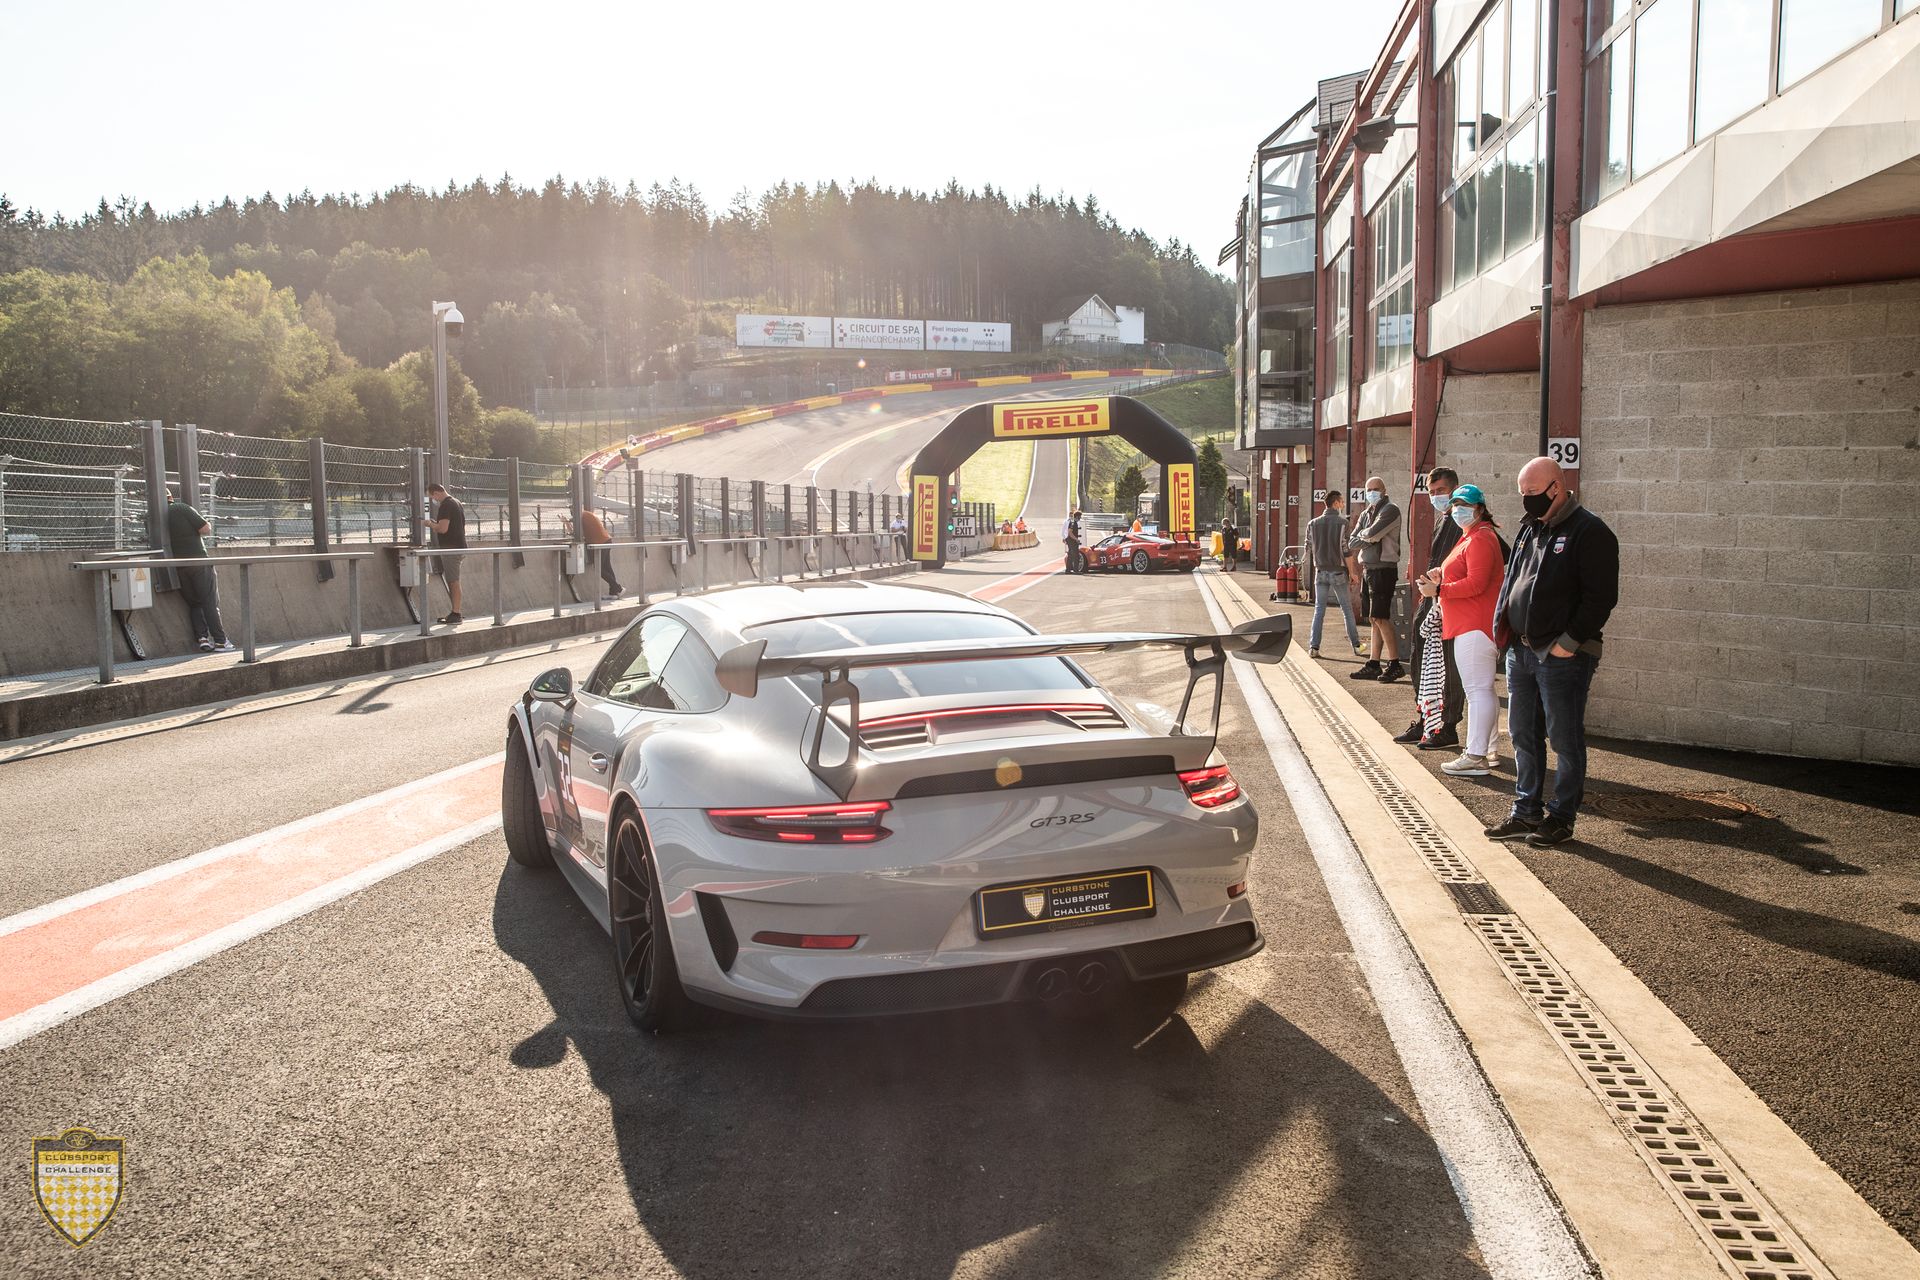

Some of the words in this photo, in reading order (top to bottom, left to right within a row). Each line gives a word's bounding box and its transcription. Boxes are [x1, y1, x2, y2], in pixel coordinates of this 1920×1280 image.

[850, 324, 886, 333] CIRCUIT
[888, 325, 900, 334] DE
[902, 325, 920, 335] SPA
[850, 334, 921, 345] FRANCORCHAMPS
[1003, 404, 1099, 431] PIRELLI
[1549, 443, 1579, 464] 39
[1314, 491, 1326, 500] 42
[1351, 490, 1365, 501] 41
[1173, 471, 1191, 542] PIRELLI
[917, 482, 934, 553] PIRELLI
[957, 517, 970, 526] PIT
[955, 526, 973, 535] EXIT
[1099, 556, 1107, 564] 33
[1051, 881, 1110, 895] CURBSTONE
[1052, 892, 1110, 906] CLUBSPORT
[1053, 903, 1111, 917] CHALLENGE
